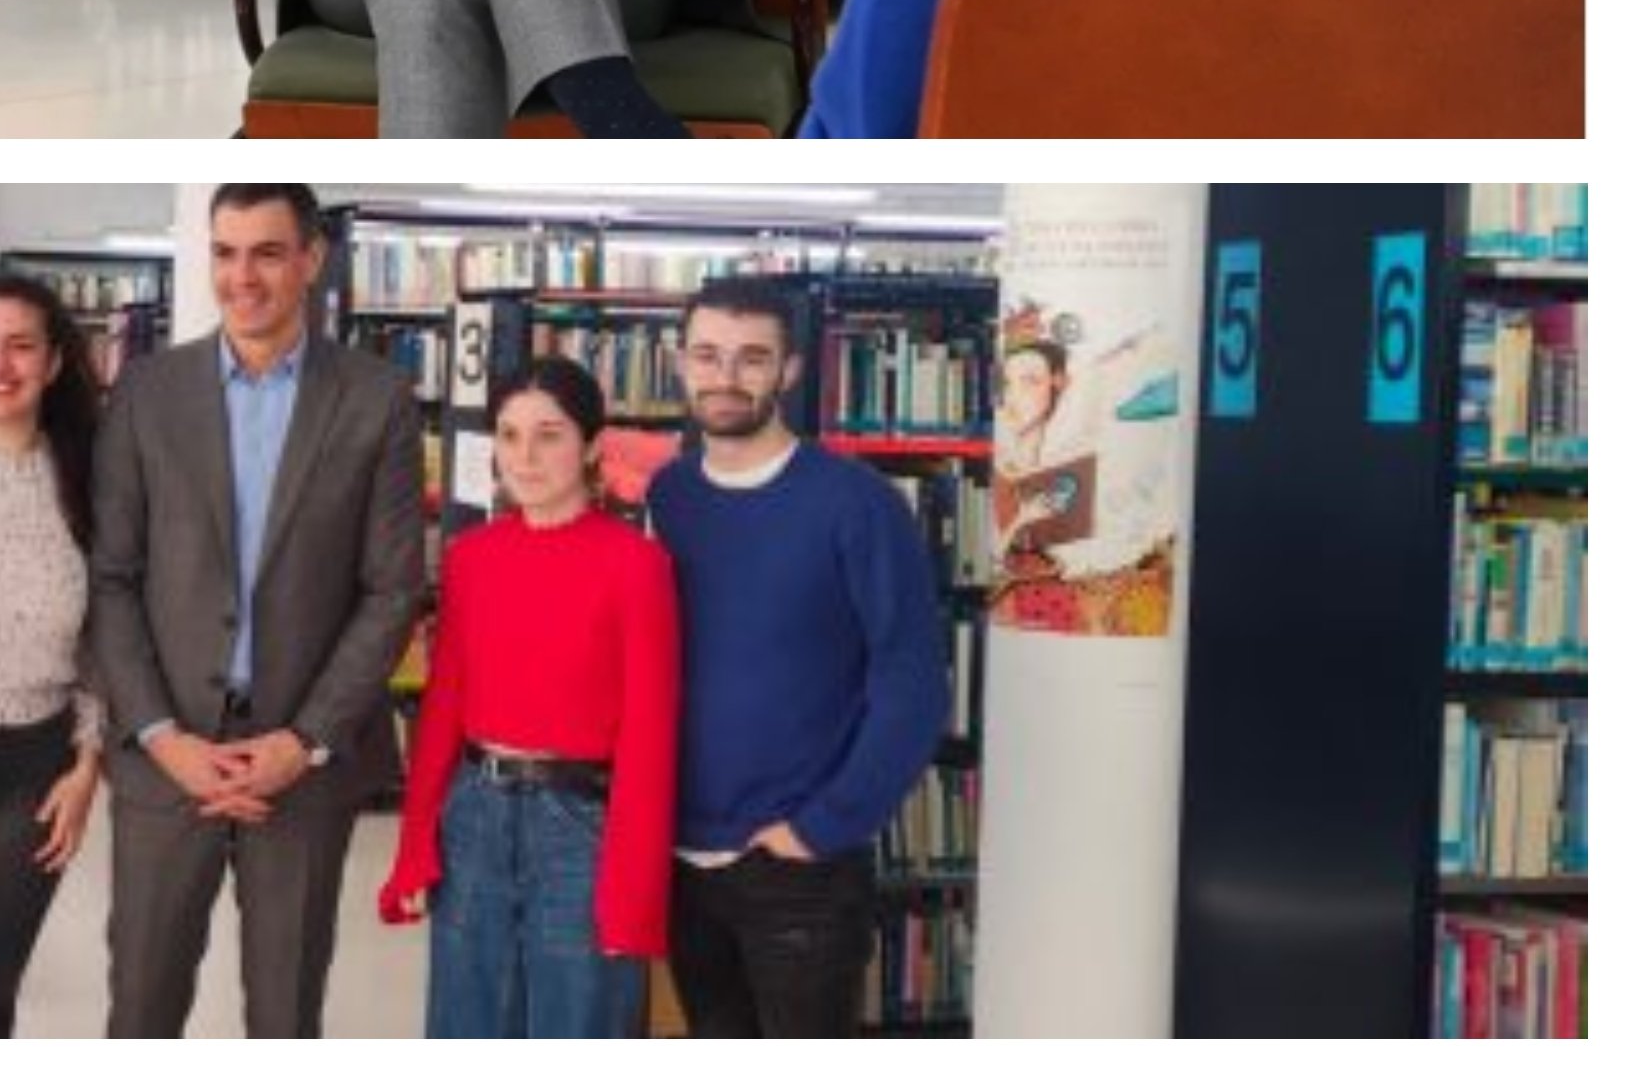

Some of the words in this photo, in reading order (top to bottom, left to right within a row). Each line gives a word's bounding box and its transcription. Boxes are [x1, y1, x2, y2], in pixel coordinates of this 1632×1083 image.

[460, 322, 484, 385] 3
[1219, 271, 1257, 379] 5
[1377, 264, 1414, 382] 6
